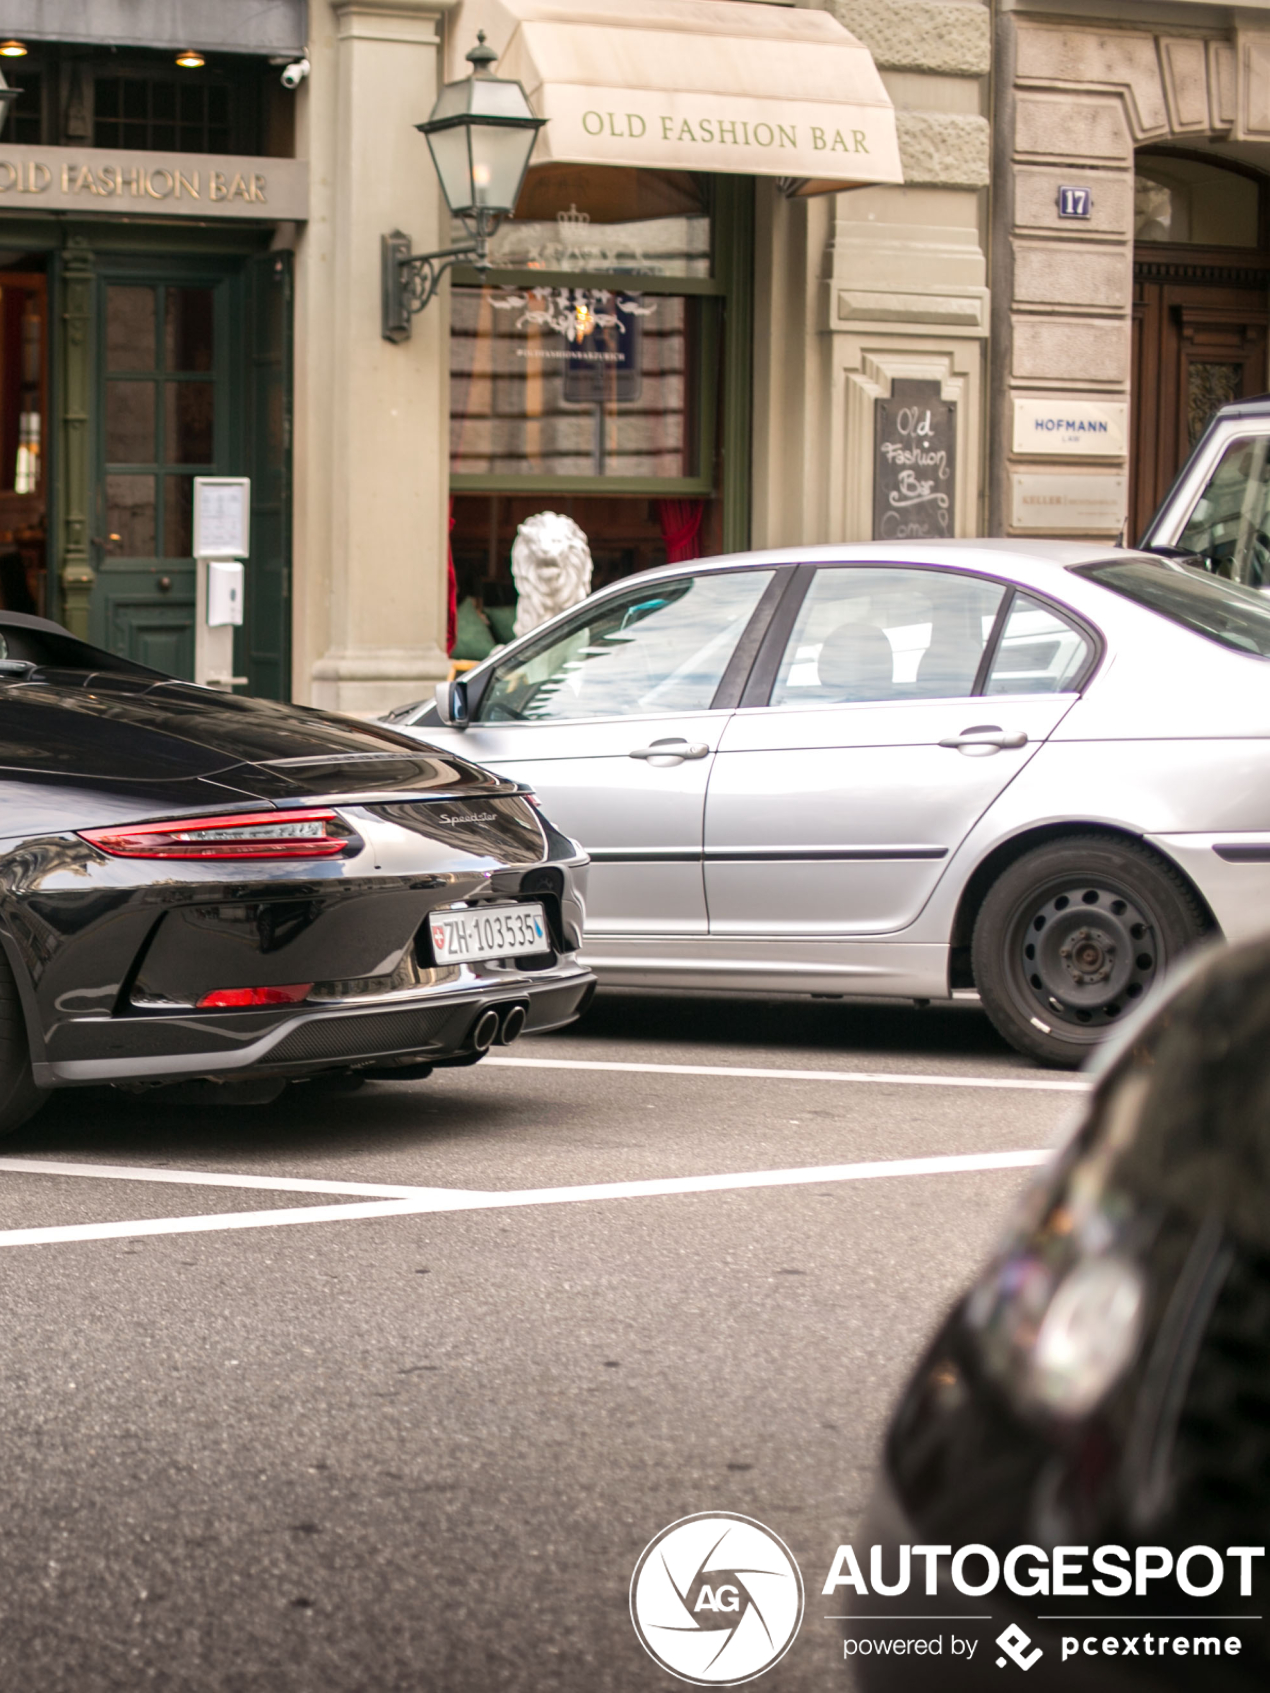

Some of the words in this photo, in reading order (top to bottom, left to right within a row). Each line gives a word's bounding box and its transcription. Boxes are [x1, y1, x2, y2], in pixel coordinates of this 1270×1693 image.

[582, 110, 647, 138] OLD
[658, 115, 798, 149] FASHION
[809, 126, 870, 154] BAR
[61, 163, 200, 200] FASHION
[209, 170, 267, 204] BAR
[1065, 190, 1086, 214] 17
[897, 405, 935, 437] Old
[1034, 418, 1108, 433] HOFMANN
[881, 440, 950, 479] Fashion
[898, 469, 935, 497] Bar
[439, 811, 498, 827] Speedster
